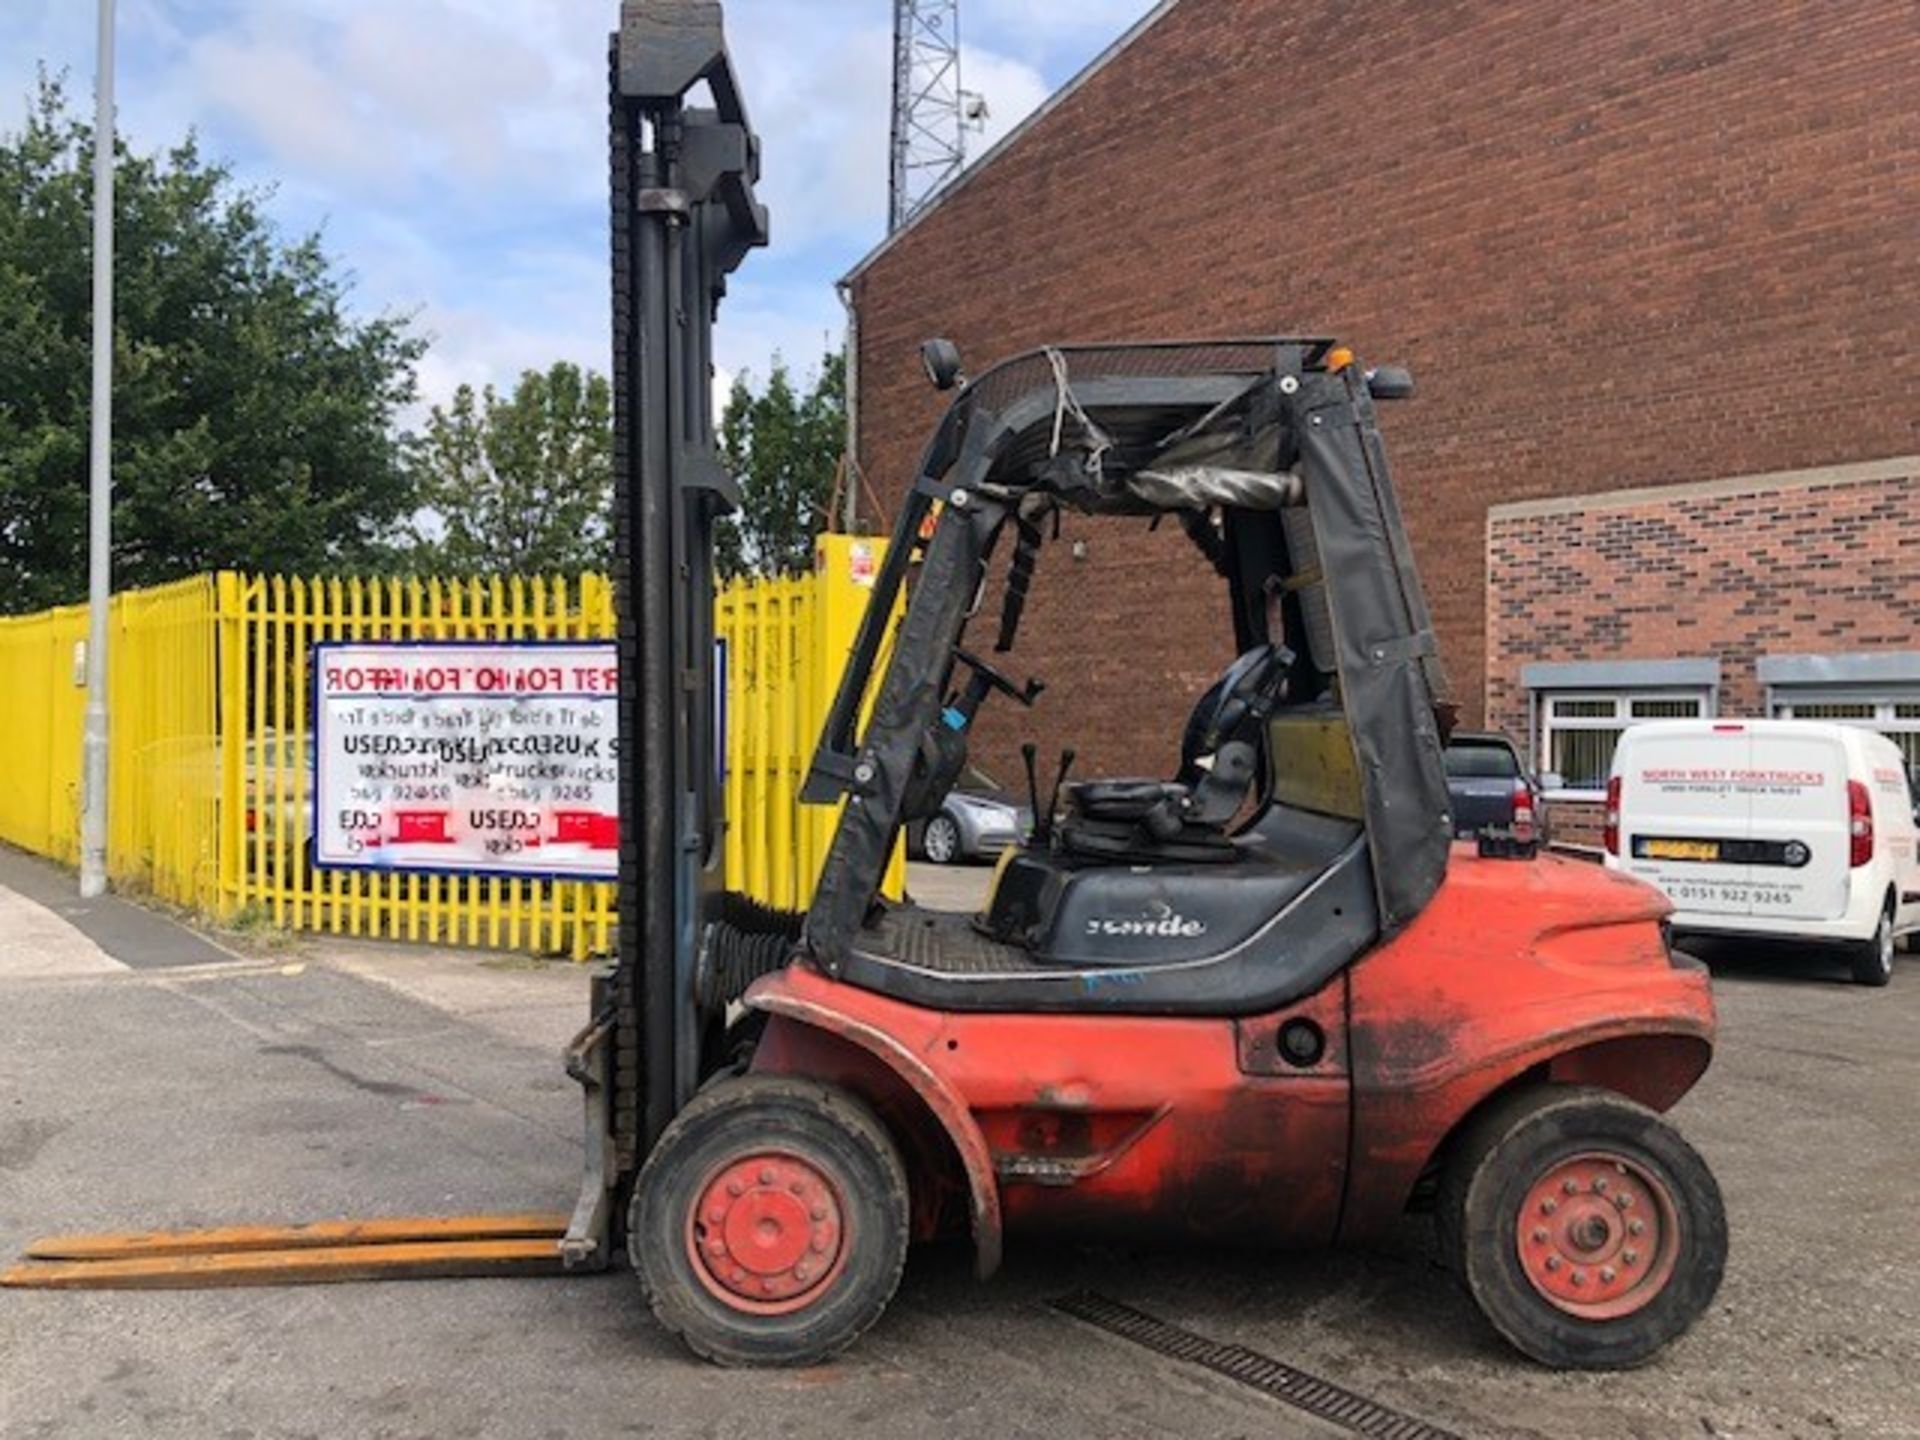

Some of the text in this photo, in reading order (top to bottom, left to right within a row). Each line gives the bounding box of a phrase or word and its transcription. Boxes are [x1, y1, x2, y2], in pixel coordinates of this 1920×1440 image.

[1680, 887, 1715, 899] 0151
[1721, 889, 1749, 902] 922
[1753, 891, 1793, 904] 9245
